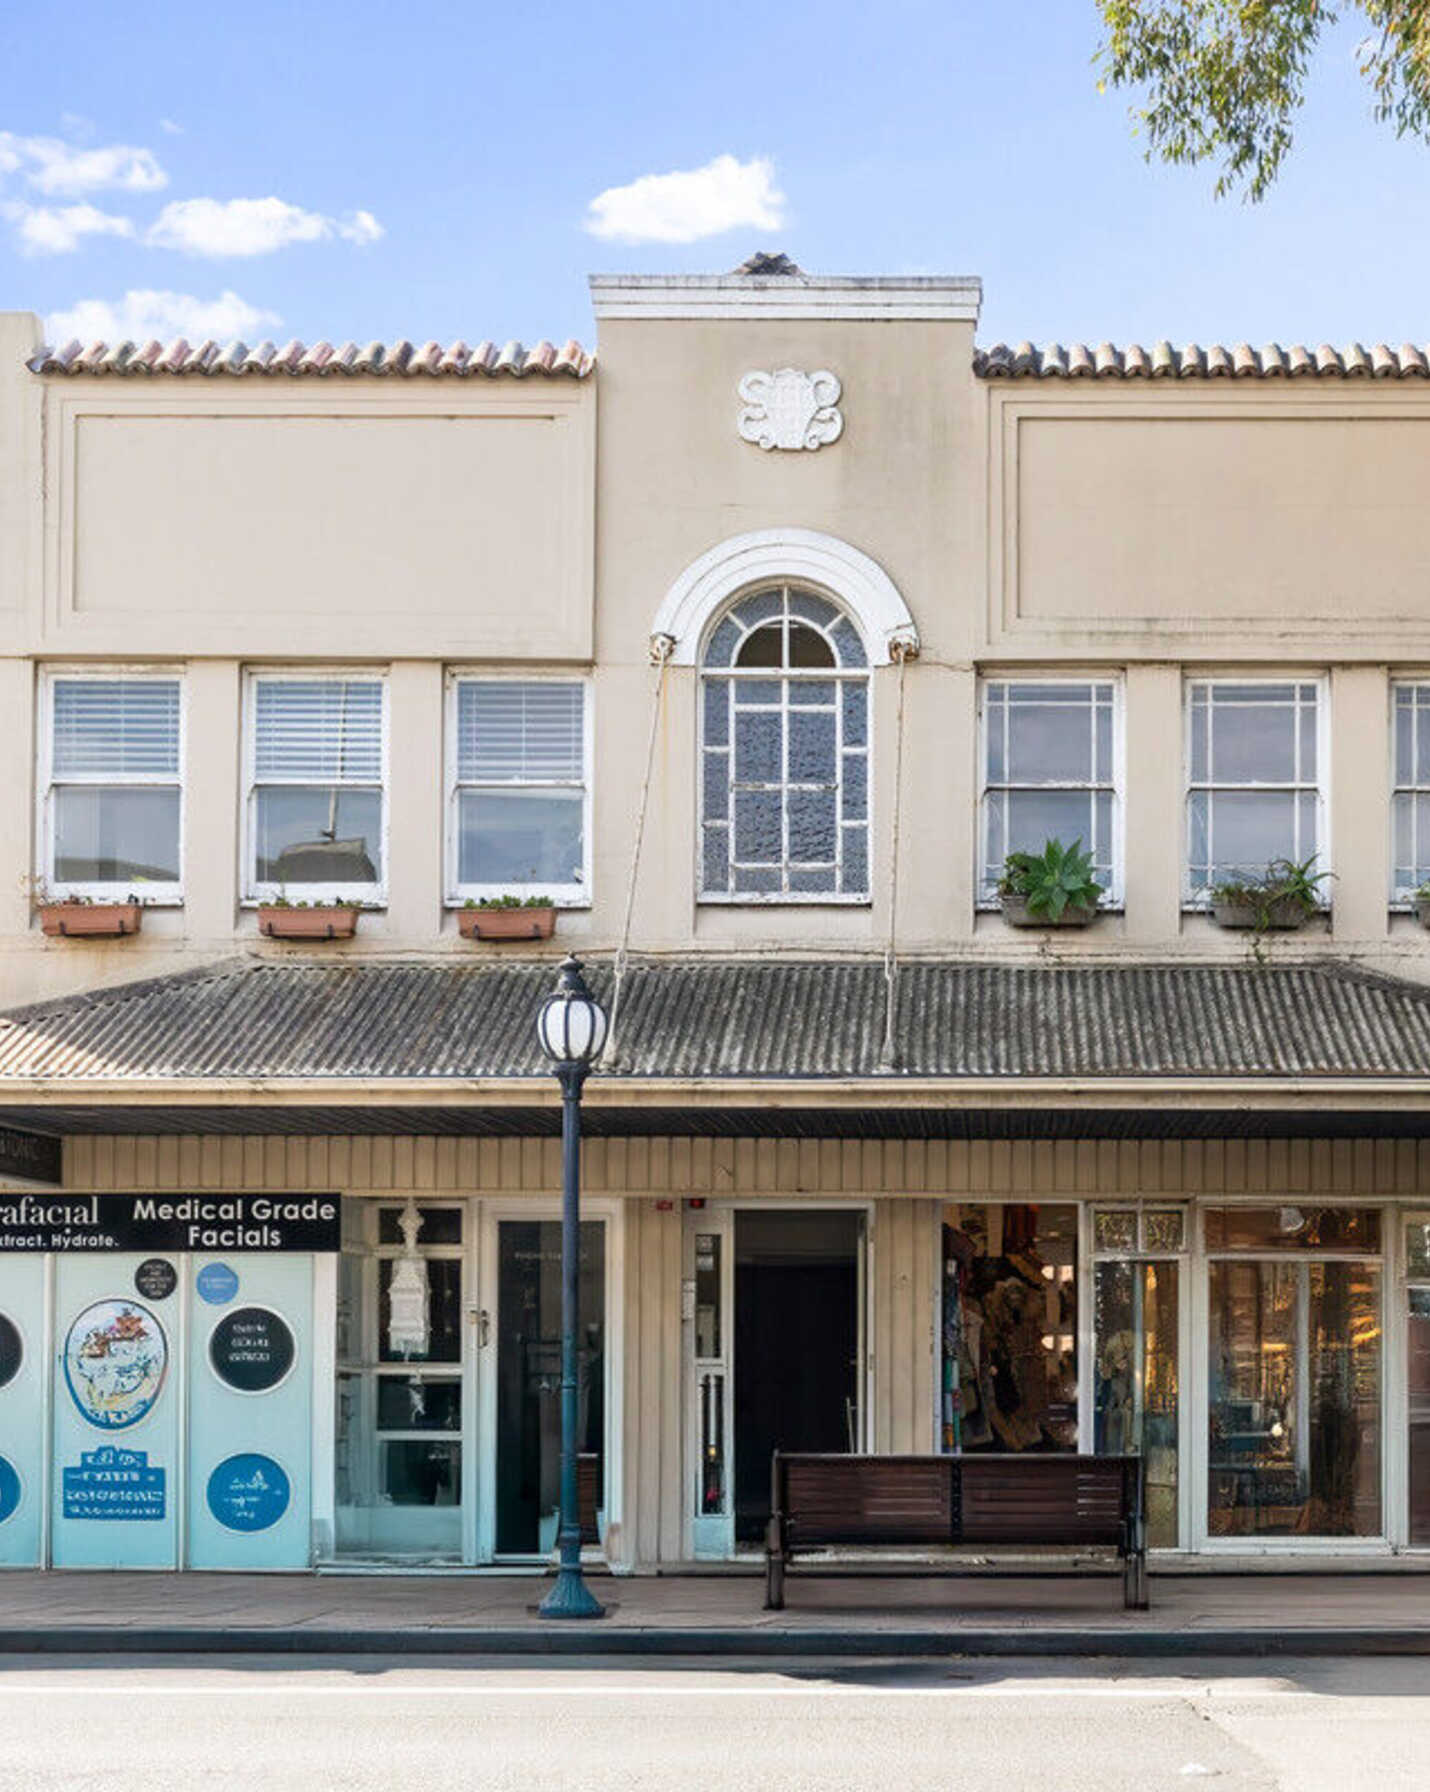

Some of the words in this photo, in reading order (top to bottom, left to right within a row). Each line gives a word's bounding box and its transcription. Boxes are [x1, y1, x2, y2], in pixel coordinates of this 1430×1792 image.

[133, 1199, 243, 1220] Medical
[251, 1199, 336, 1220] Grade
[51, 1234, 119, 1249] Hydrate.
[188, 1225, 281, 1247] Facials
